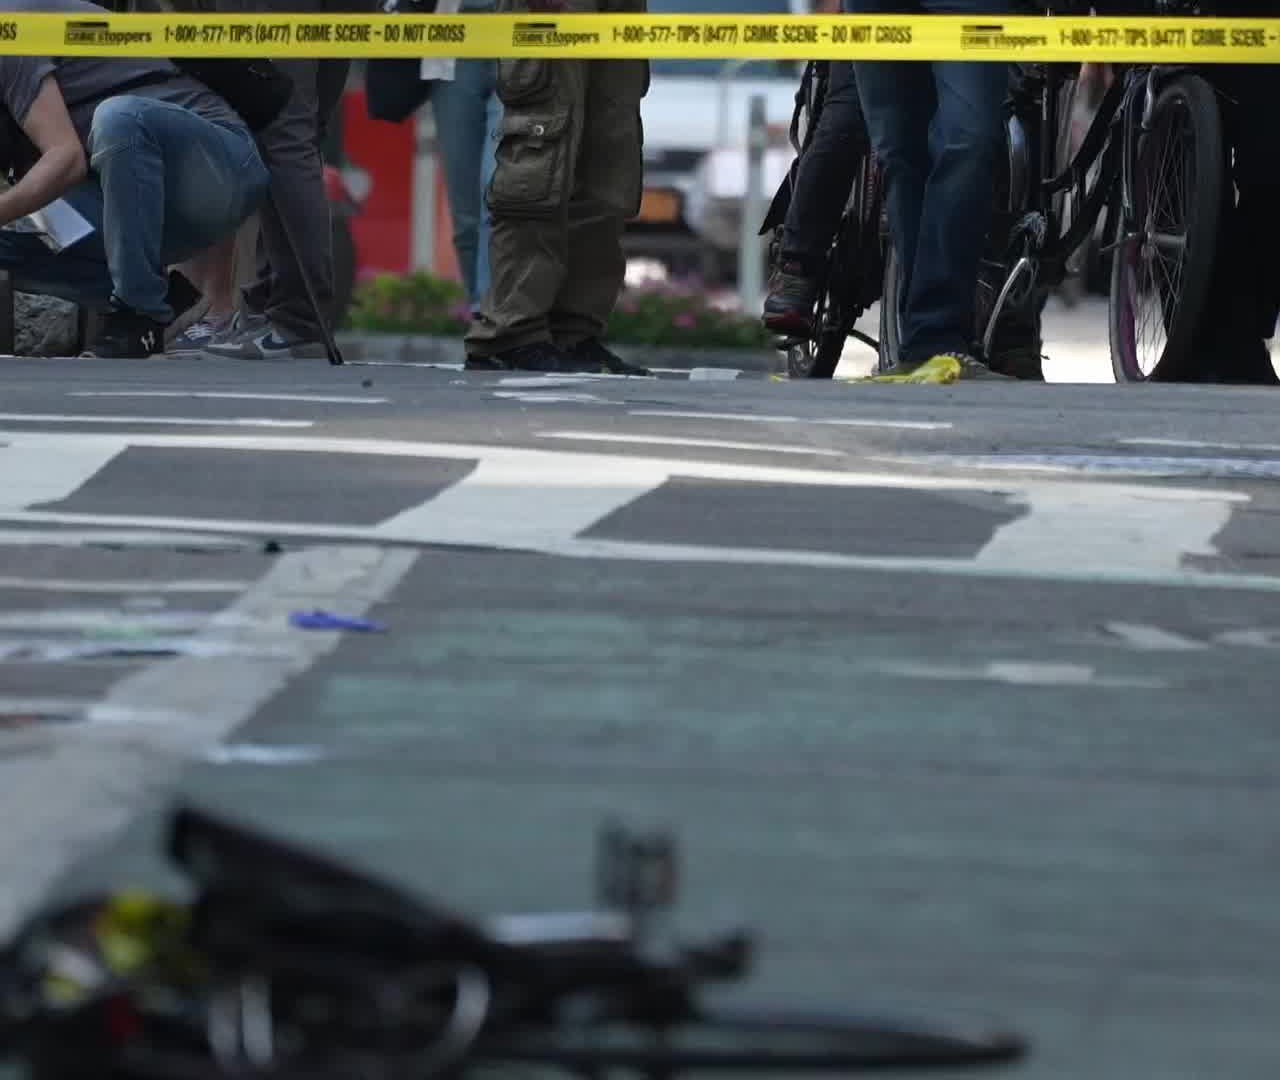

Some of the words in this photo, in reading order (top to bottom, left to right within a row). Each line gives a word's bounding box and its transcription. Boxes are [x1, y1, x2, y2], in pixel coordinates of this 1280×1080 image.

[98, 29, 153, 46] stoppers
[164, 25, 253, 43] 1-800-577-TIPS
[255, 24, 291, 44] (8477)
[296, 24, 332, 42] CRIME
[335, 24, 371, 42] SCENE
[384, 24, 400, 42] DO
[403, 24, 425, 42] NOT
[427, 24, 466, 43] CROSS
[612, 25, 701, 43] 1-800-577-TIPS
[703, 25, 738, 44] (8477)
[743, 25, 779, 43] CRIME
[782, 25, 818, 43] SCENE
[832, 26, 848, 43] DO
[850, 26, 872, 43] NOT
[875, 26, 912, 44] CROSS
[1191, 29, 1226, 47] CRIME
[1230, 29, 1265, 47] SCENE
